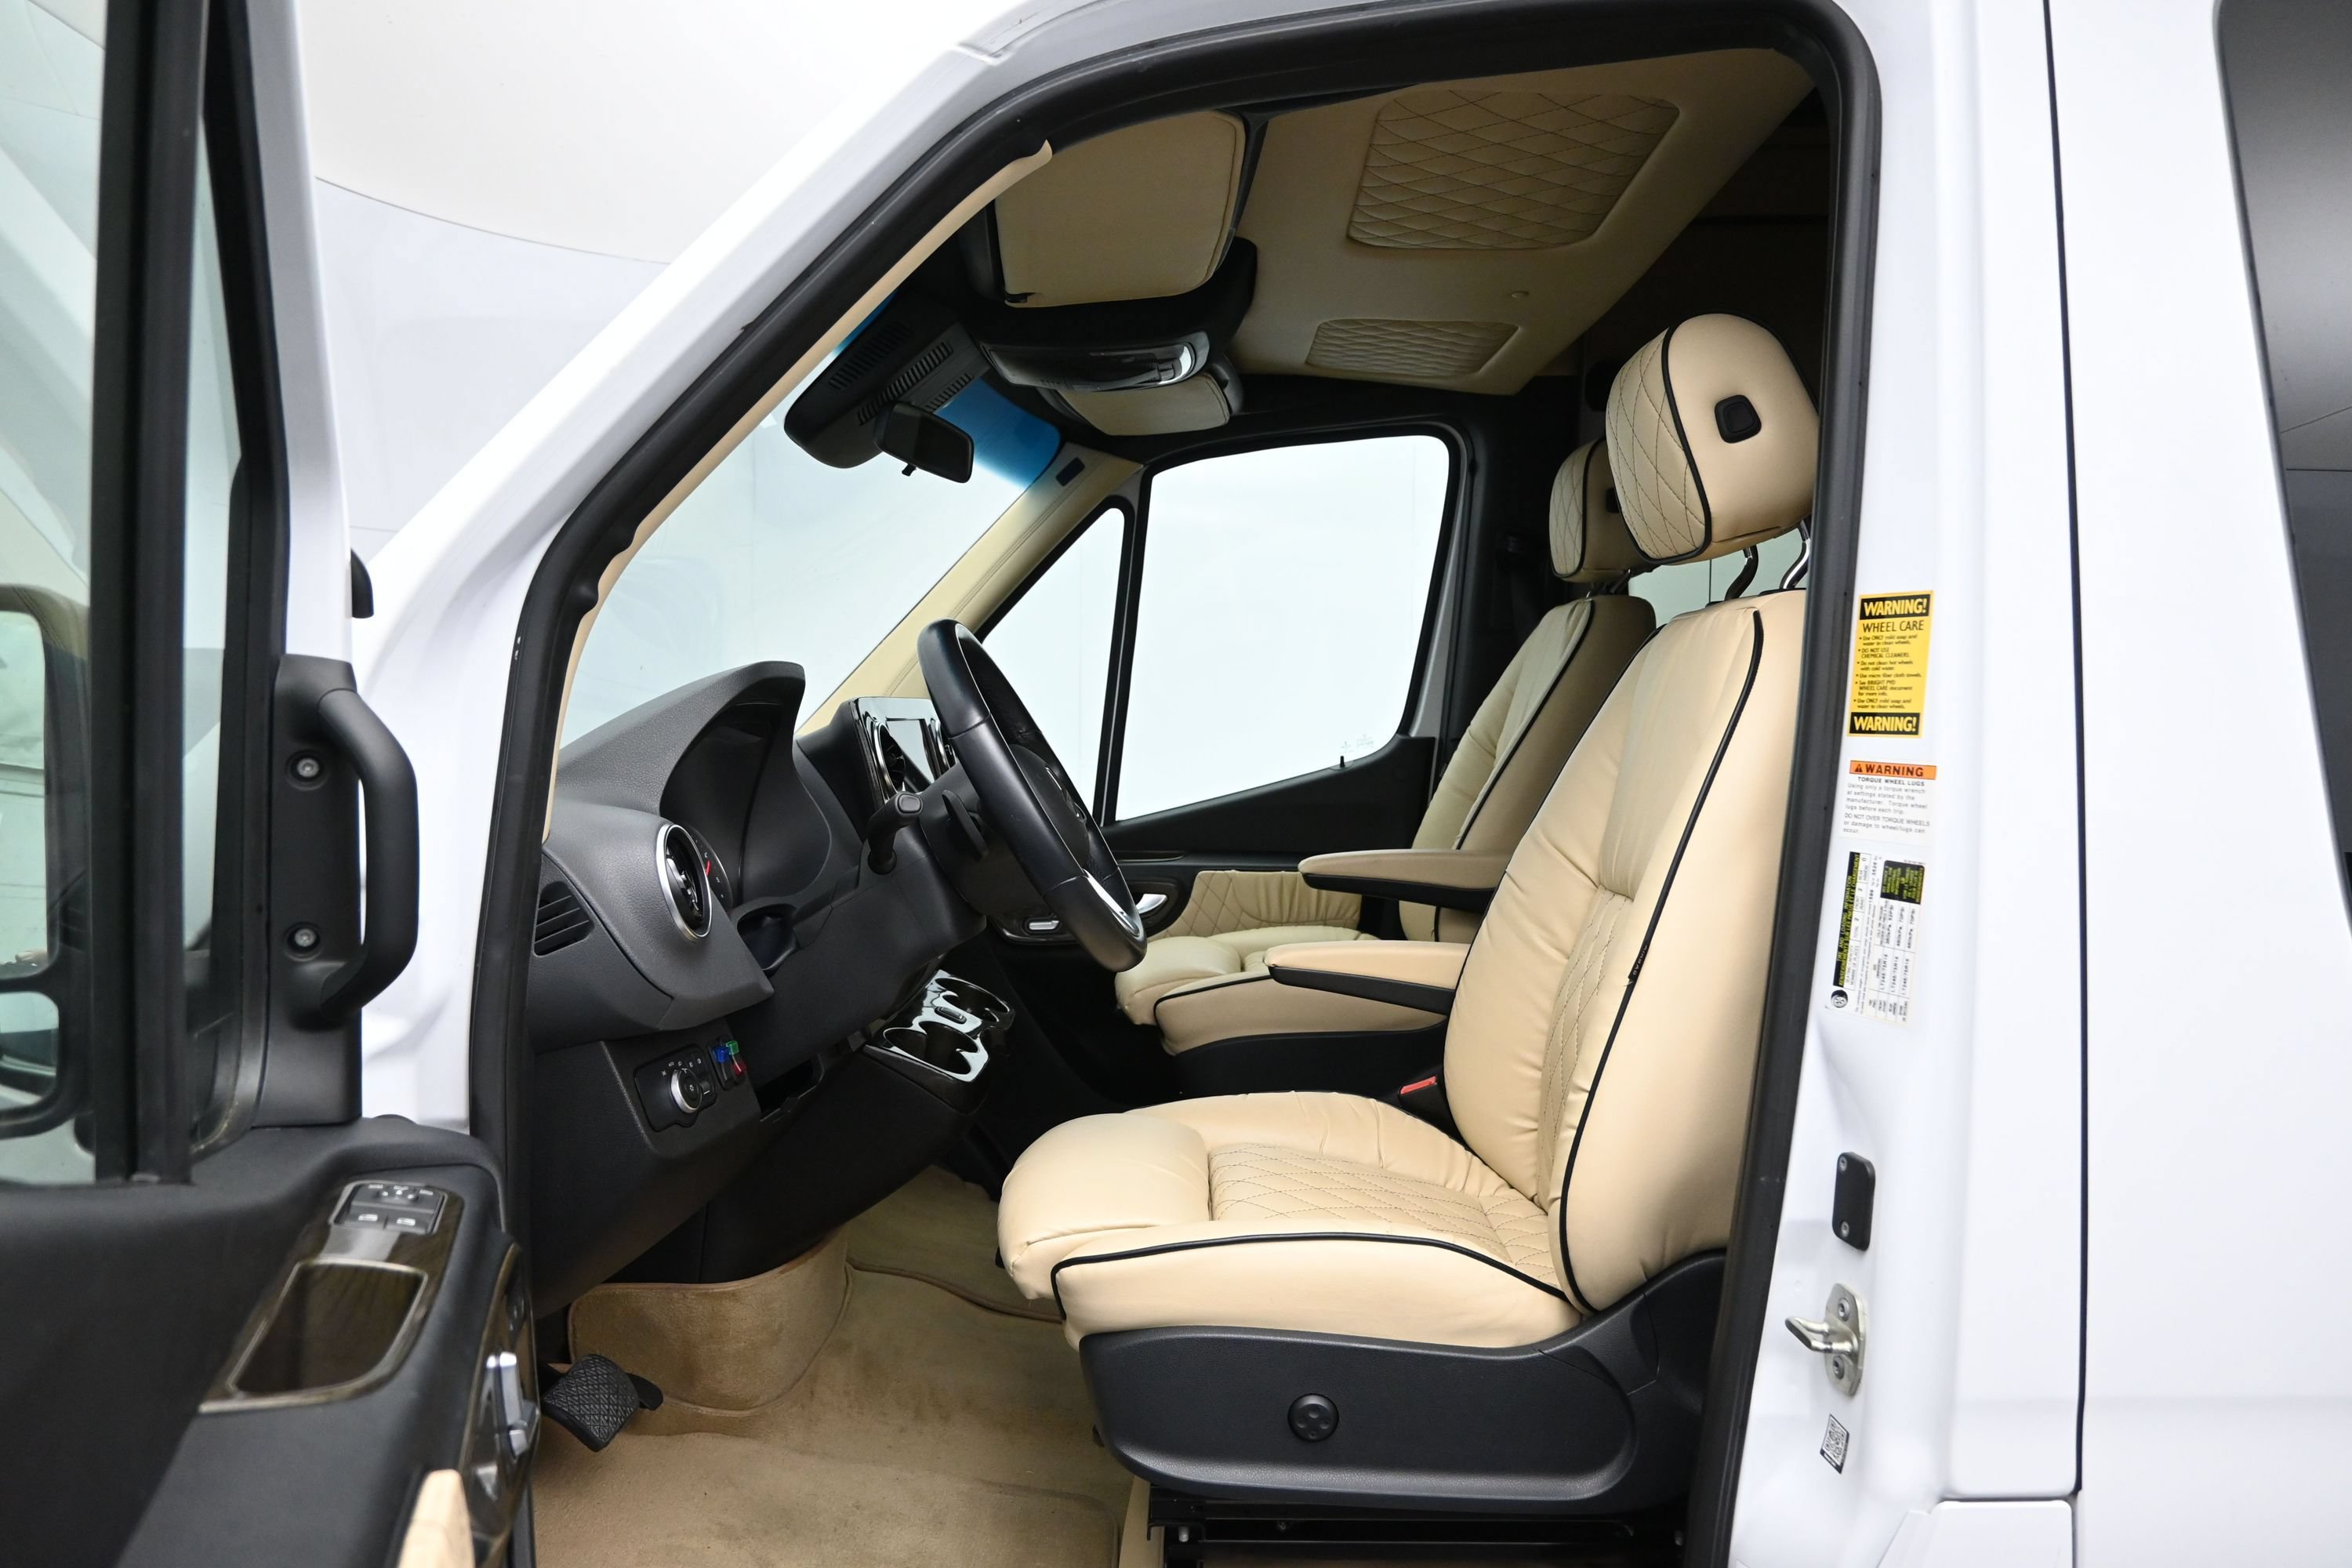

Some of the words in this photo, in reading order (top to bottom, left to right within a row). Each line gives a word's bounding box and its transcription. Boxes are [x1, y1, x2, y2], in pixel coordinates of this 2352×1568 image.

[1864, 598, 1927, 616] WARNING!
[1863, 622, 1896, 633] WHEEL
[1900, 620, 1925, 631] CARE
[1854, 716, 1917, 731] WARNING!
[1865, 764, 1923, 777] WARNING
[1843, 875, 1852, 909] INFORMATION
[1838, 942, 1849, 985] RENSEIGNEMENTS
[1851, 853, 1860, 887] CHARGEMENT
